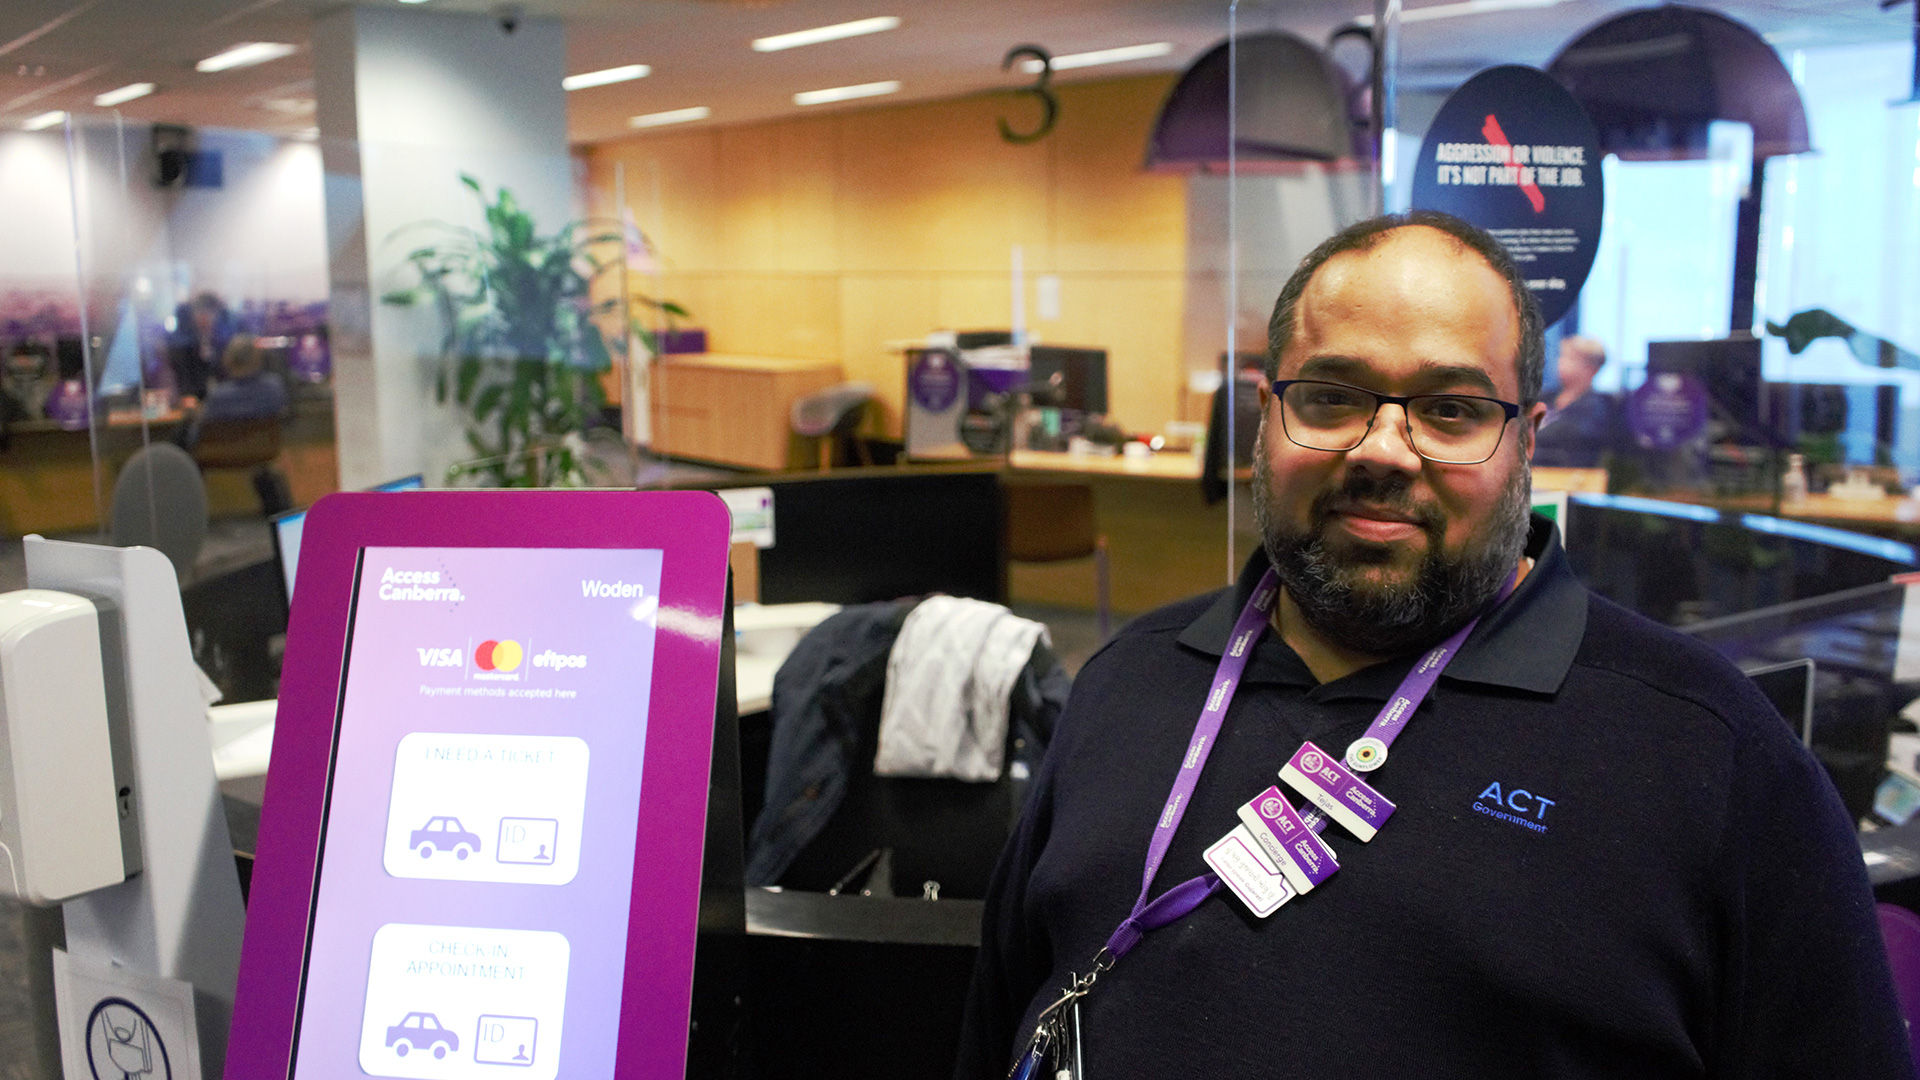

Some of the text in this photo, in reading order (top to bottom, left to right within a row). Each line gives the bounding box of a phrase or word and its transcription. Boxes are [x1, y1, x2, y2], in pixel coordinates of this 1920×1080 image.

[997, 44, 1060, 144] 3
[1436, 142, 1511, 163] AGGRESSION
[1512, 144, 1530, 164] OR
[1437, 165, 1462, 185] IT'S
[1462, 165, 1487, 185] NOT
[1488, 166, 1518, 185] PART
[1519, 166, 1536, 186] OF
[1537, 167, 1559, 186] THE
[380, 567, 440, 584] Access
[379, 584, 465, 602] Canberra.
[581, 580, 644, 598] Woden
[416, 648, 463, 667] VISA
[532, 649, 588, 672] eftpos
[419, 685, 577, 700] Payment methods accepted here
[1206, 688, 1222, 712] Access
[1391, 698, 1412, 722] Access
[434, 747, 478, 761] NEED
[482, 749, 494, 761] A
[501, 750, 555, 763] TICKET
[1183, 745, 1198, 769] Access
[1320, 766, 1341, 783] ACT
[1316, 793, 1334, 811] Tejas
[1349, 786, 1373, 805] Access
[1478, 781, 1556, 819] ACT
[1160, 804, 1174, 828] Access
[1277, 815, 1296, 832] ACT
[1472, 801, 1548, 834] Government
[504, 825, 527, 844] ID
[1259, 832, 1287, 867] Concierge
[1299, 839, 1319, 862] Access
[1244, 881, 1264, 903] Gujarati
[406, 960, 526, 980] APPOINTMENT
[483, 1023, 505, 1043] ID
